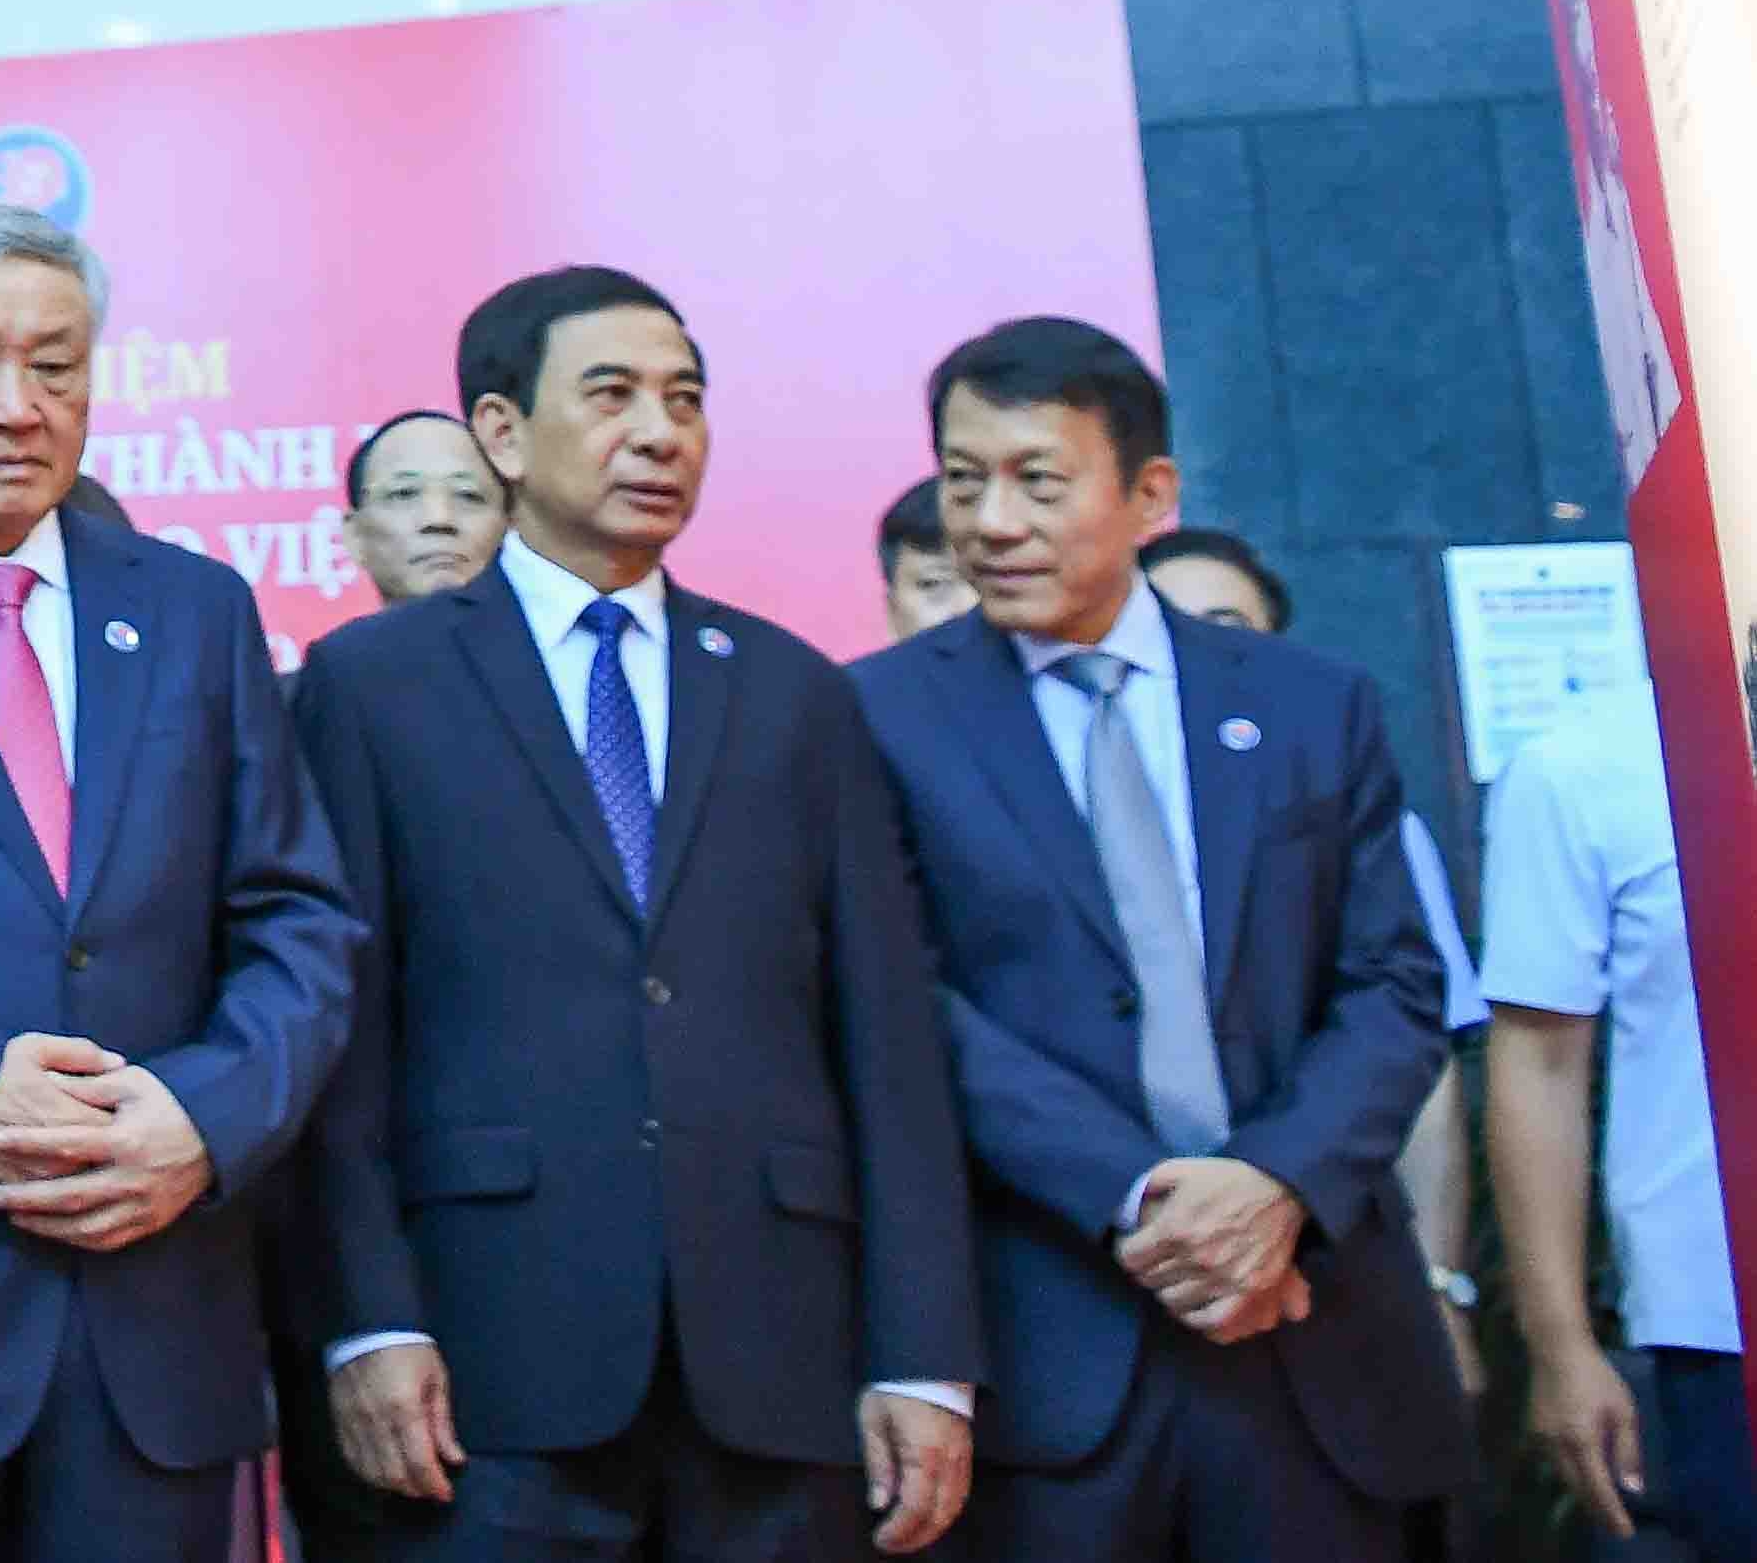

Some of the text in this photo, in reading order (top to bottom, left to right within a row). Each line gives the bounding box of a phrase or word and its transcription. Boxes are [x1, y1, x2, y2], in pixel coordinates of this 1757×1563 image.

[90, 328, 232, 414] IỆM
[80, 414, 336, 497] THÀNH
[222, 504, 360, 598] VIỆ
